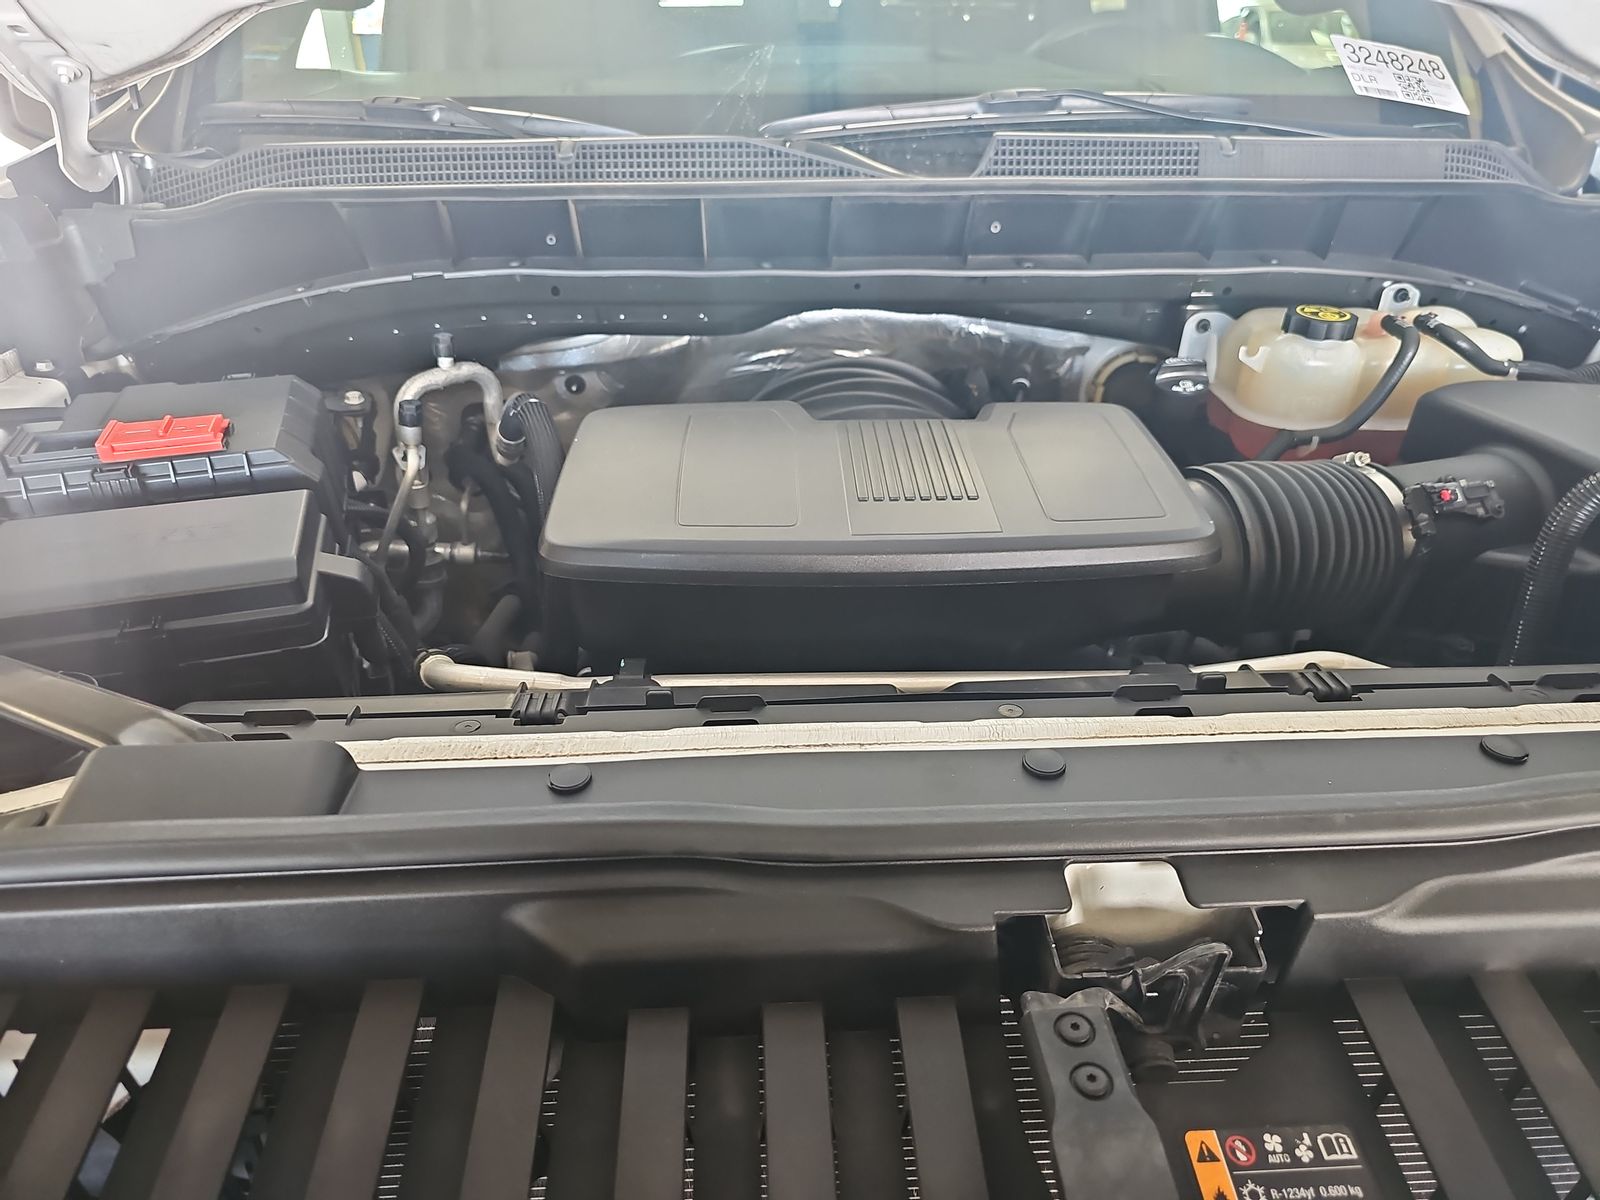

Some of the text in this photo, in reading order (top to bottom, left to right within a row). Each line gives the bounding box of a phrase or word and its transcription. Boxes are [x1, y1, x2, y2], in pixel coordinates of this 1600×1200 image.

[1343, 43, 1445, 80] 3248248
[1350, 72, 1378, 84] DLR
[1268, 1153, 1291, 1163] AUTO
[1270, 1184, 1364, 1200] R-1234yf 0.600 kg
